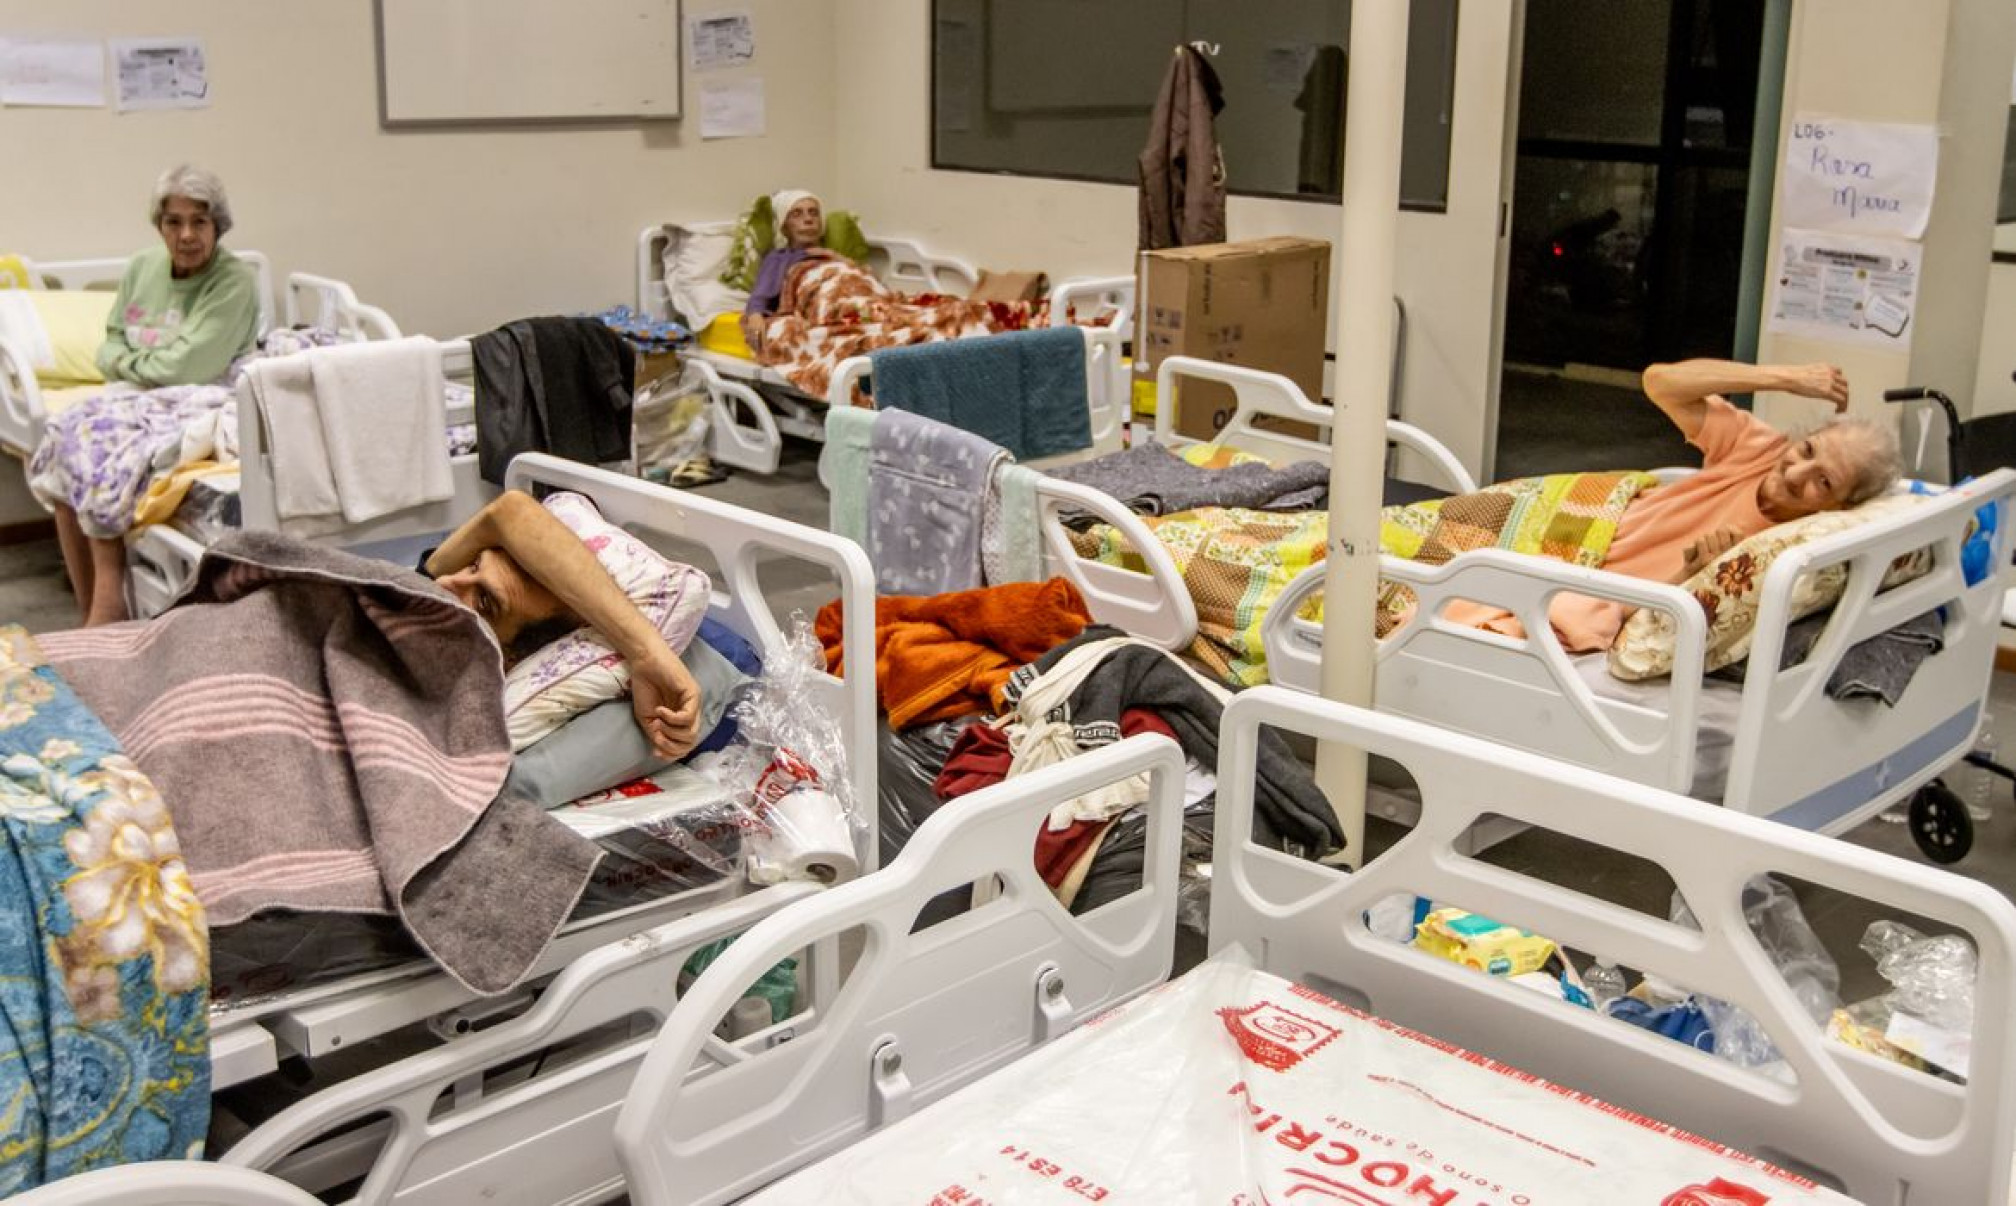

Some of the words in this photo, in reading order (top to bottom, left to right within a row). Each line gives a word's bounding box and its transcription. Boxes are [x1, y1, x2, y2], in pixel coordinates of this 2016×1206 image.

[1405, 1142, 1434, 1159] de
[1442, 1164, 1503, 1193] sono
[1511, 1194, 1531, 1205] O
